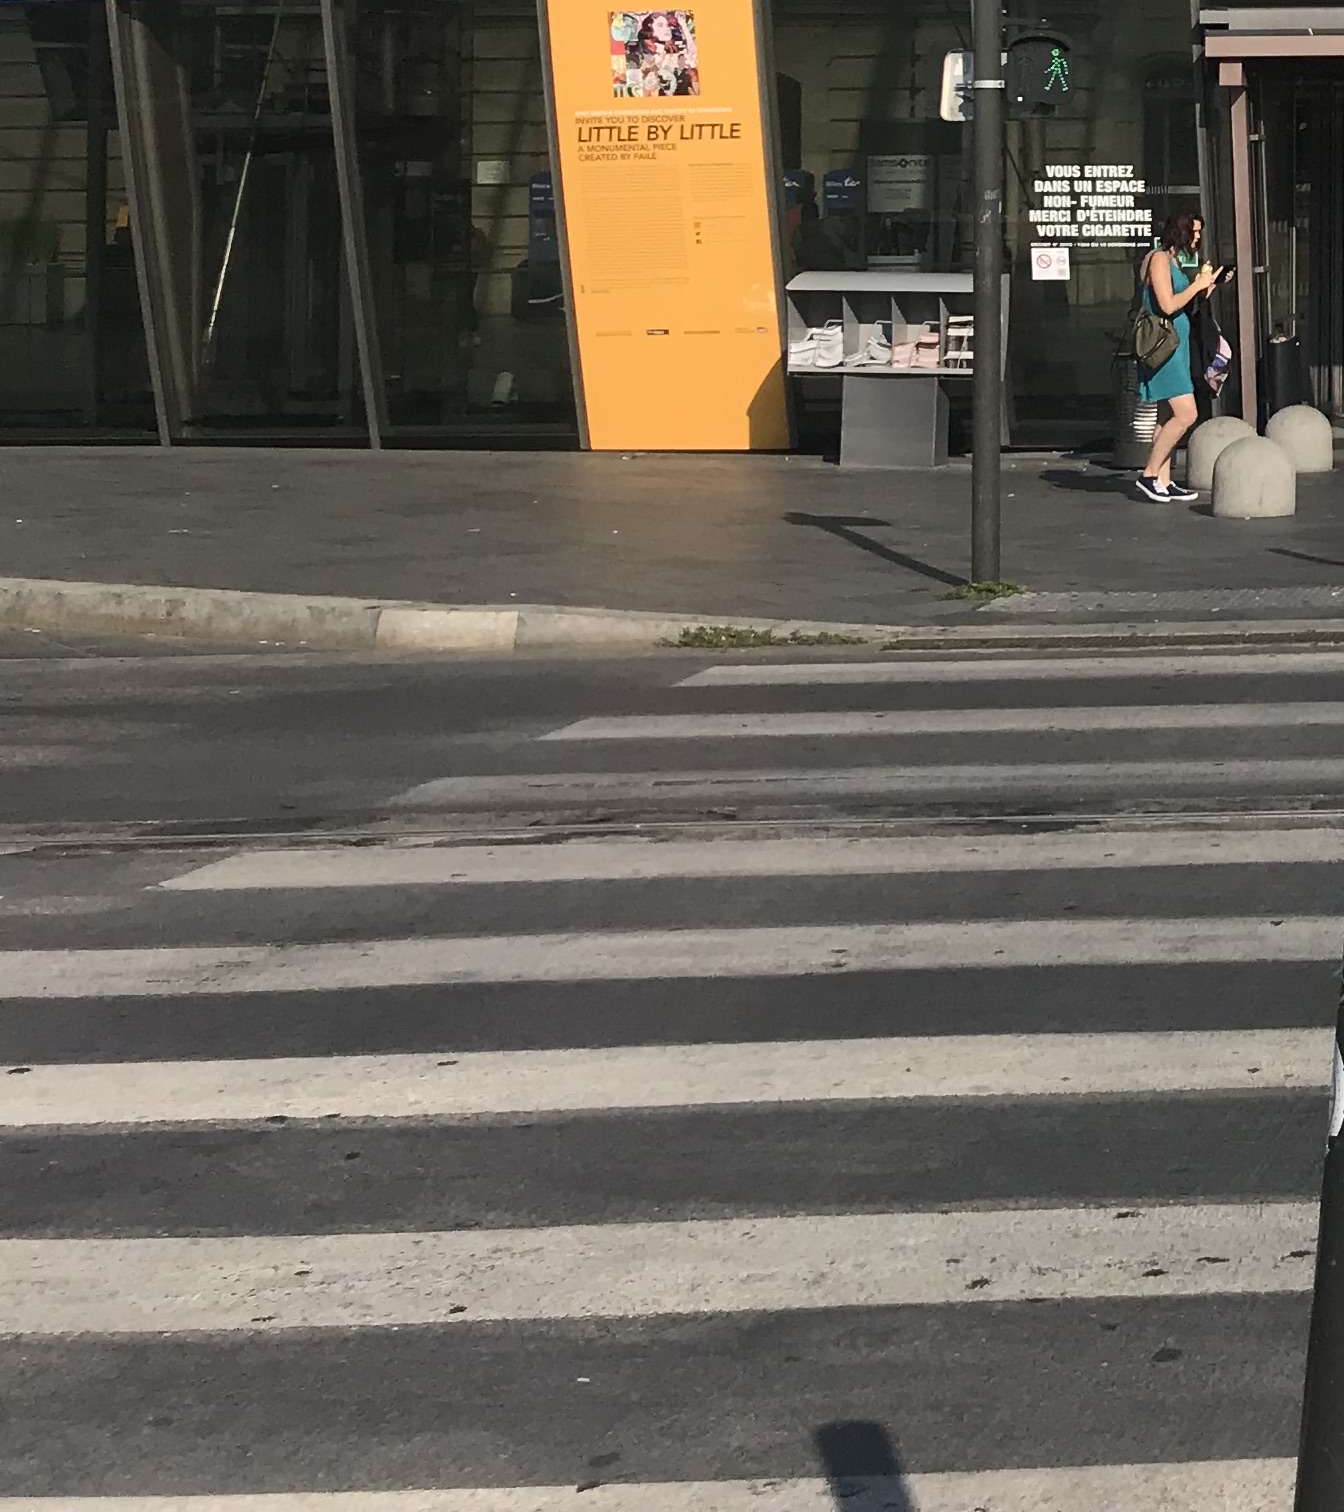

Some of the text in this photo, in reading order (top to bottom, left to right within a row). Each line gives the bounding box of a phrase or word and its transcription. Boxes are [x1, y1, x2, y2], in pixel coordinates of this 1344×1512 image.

[577, 123, 742, 143] LITTLE BY LITTLE
[1045, 165, 1134, 178] VOUS ENTREZ
[1034, 180, 1146, 193] DANS UN ESPACE
[1029, 210, 1071, 222] MERCI
[1036, 224, 1152, 237] VOTRE CIGARETTE
